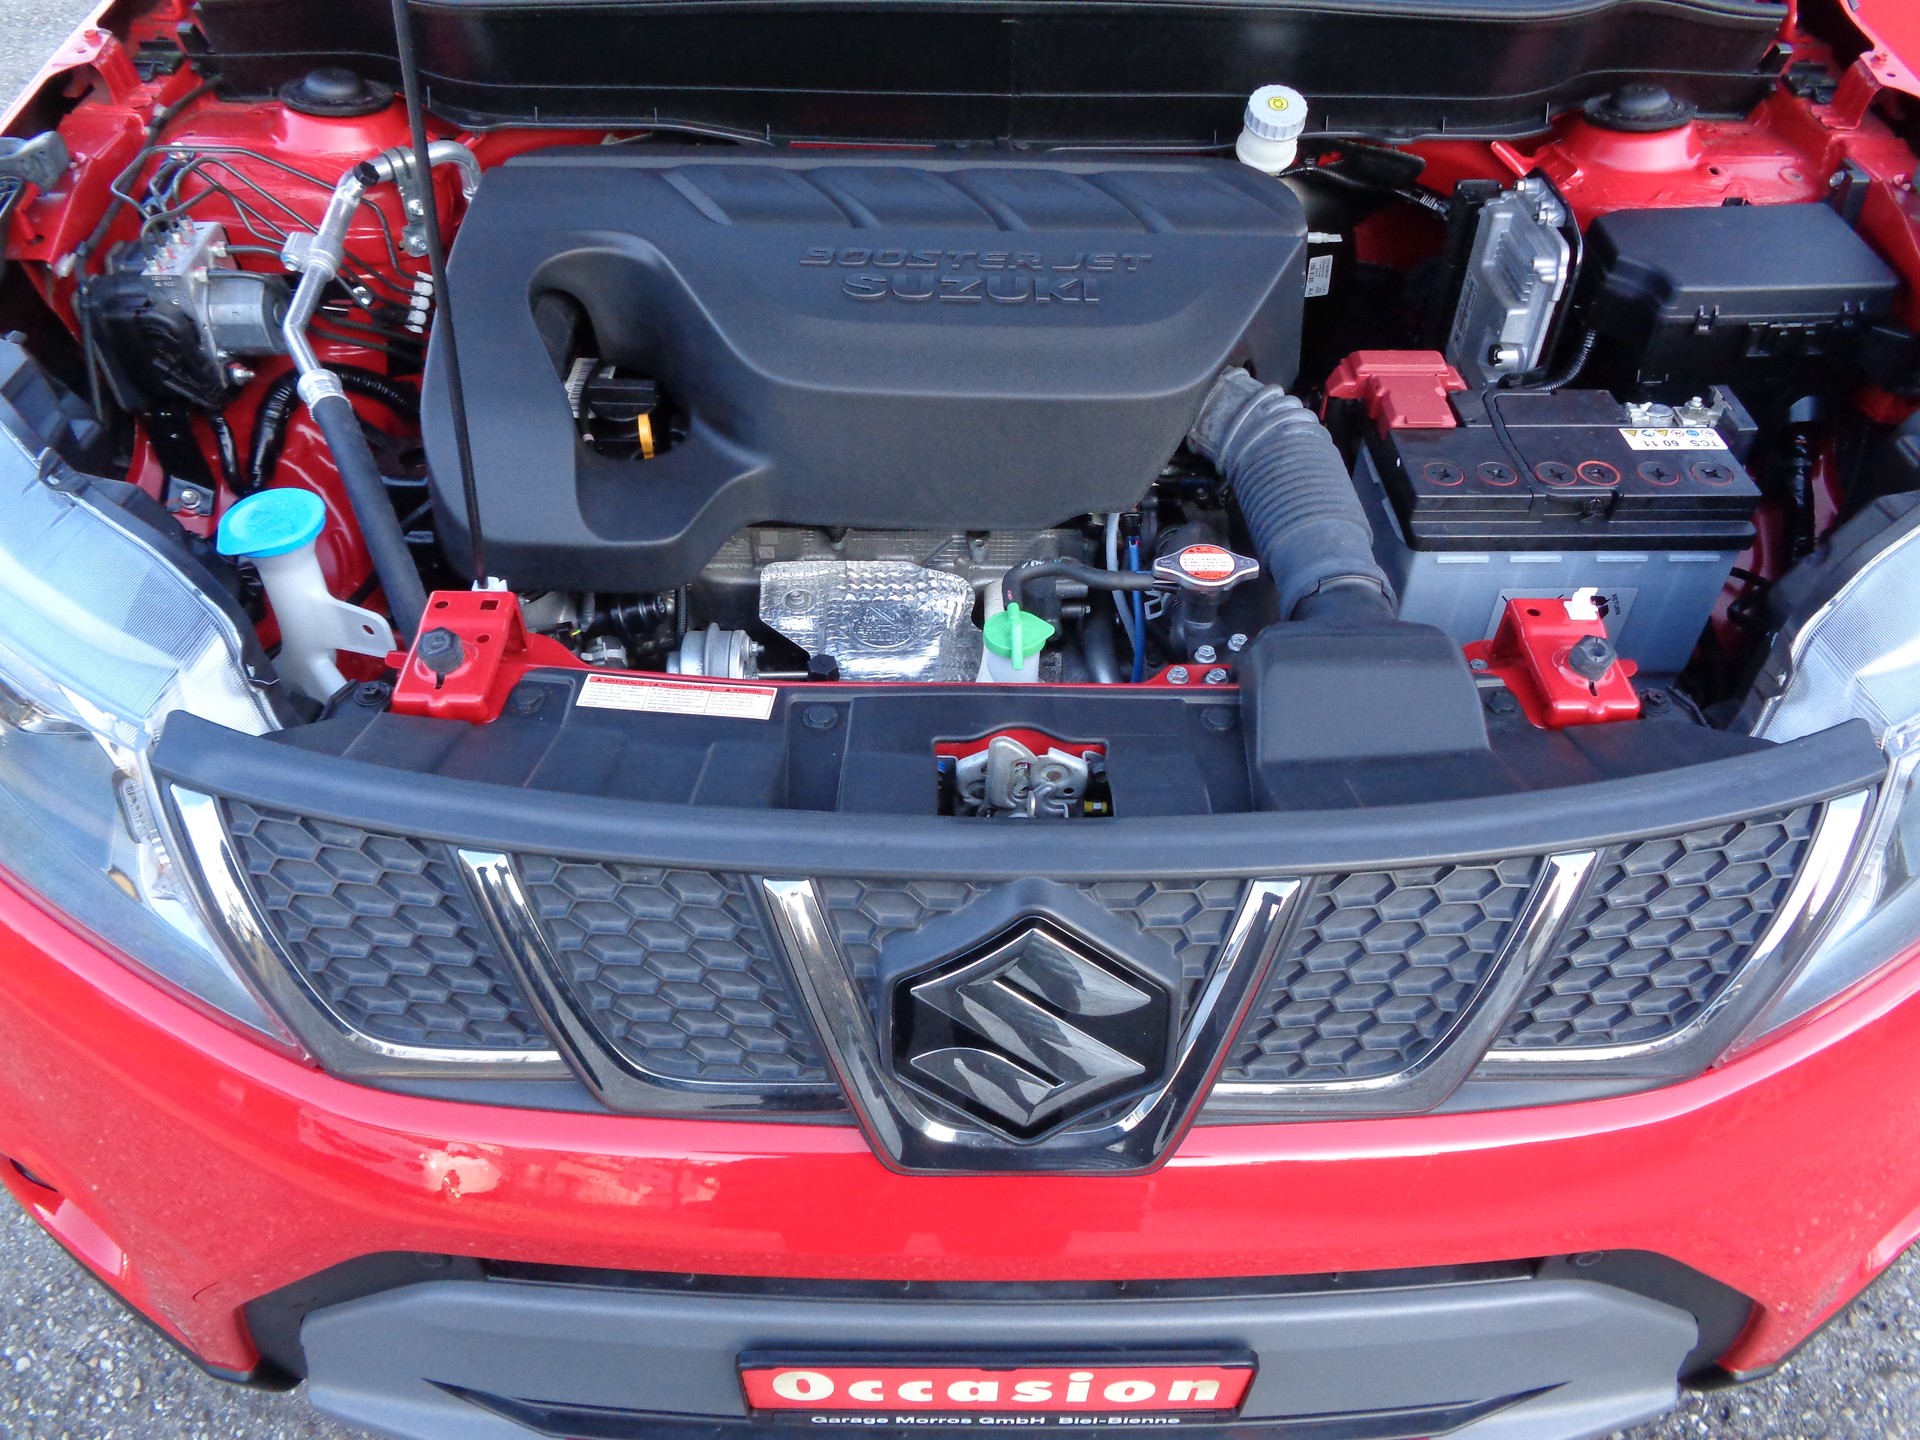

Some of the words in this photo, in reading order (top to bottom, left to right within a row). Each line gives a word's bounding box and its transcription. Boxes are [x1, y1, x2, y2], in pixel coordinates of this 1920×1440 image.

[843, 272, 1100, 302] SUZUKI
[1644, 439, 1658, 447] 11
[1663, 439, 1679, 447] 60
[1690, 439, 1720, 448] TCS
[1611, 593, 1621, 615] RETURN
[772, 1370, 1222, 1404] Occasion
[810, 1415, 889, 1425] Garage
[895, 1415, 972, 1425] Morros
[978, 1415, 1046, 1425] GmbH
[1058, 1415, 1181, 1426] Biel-Bienne
